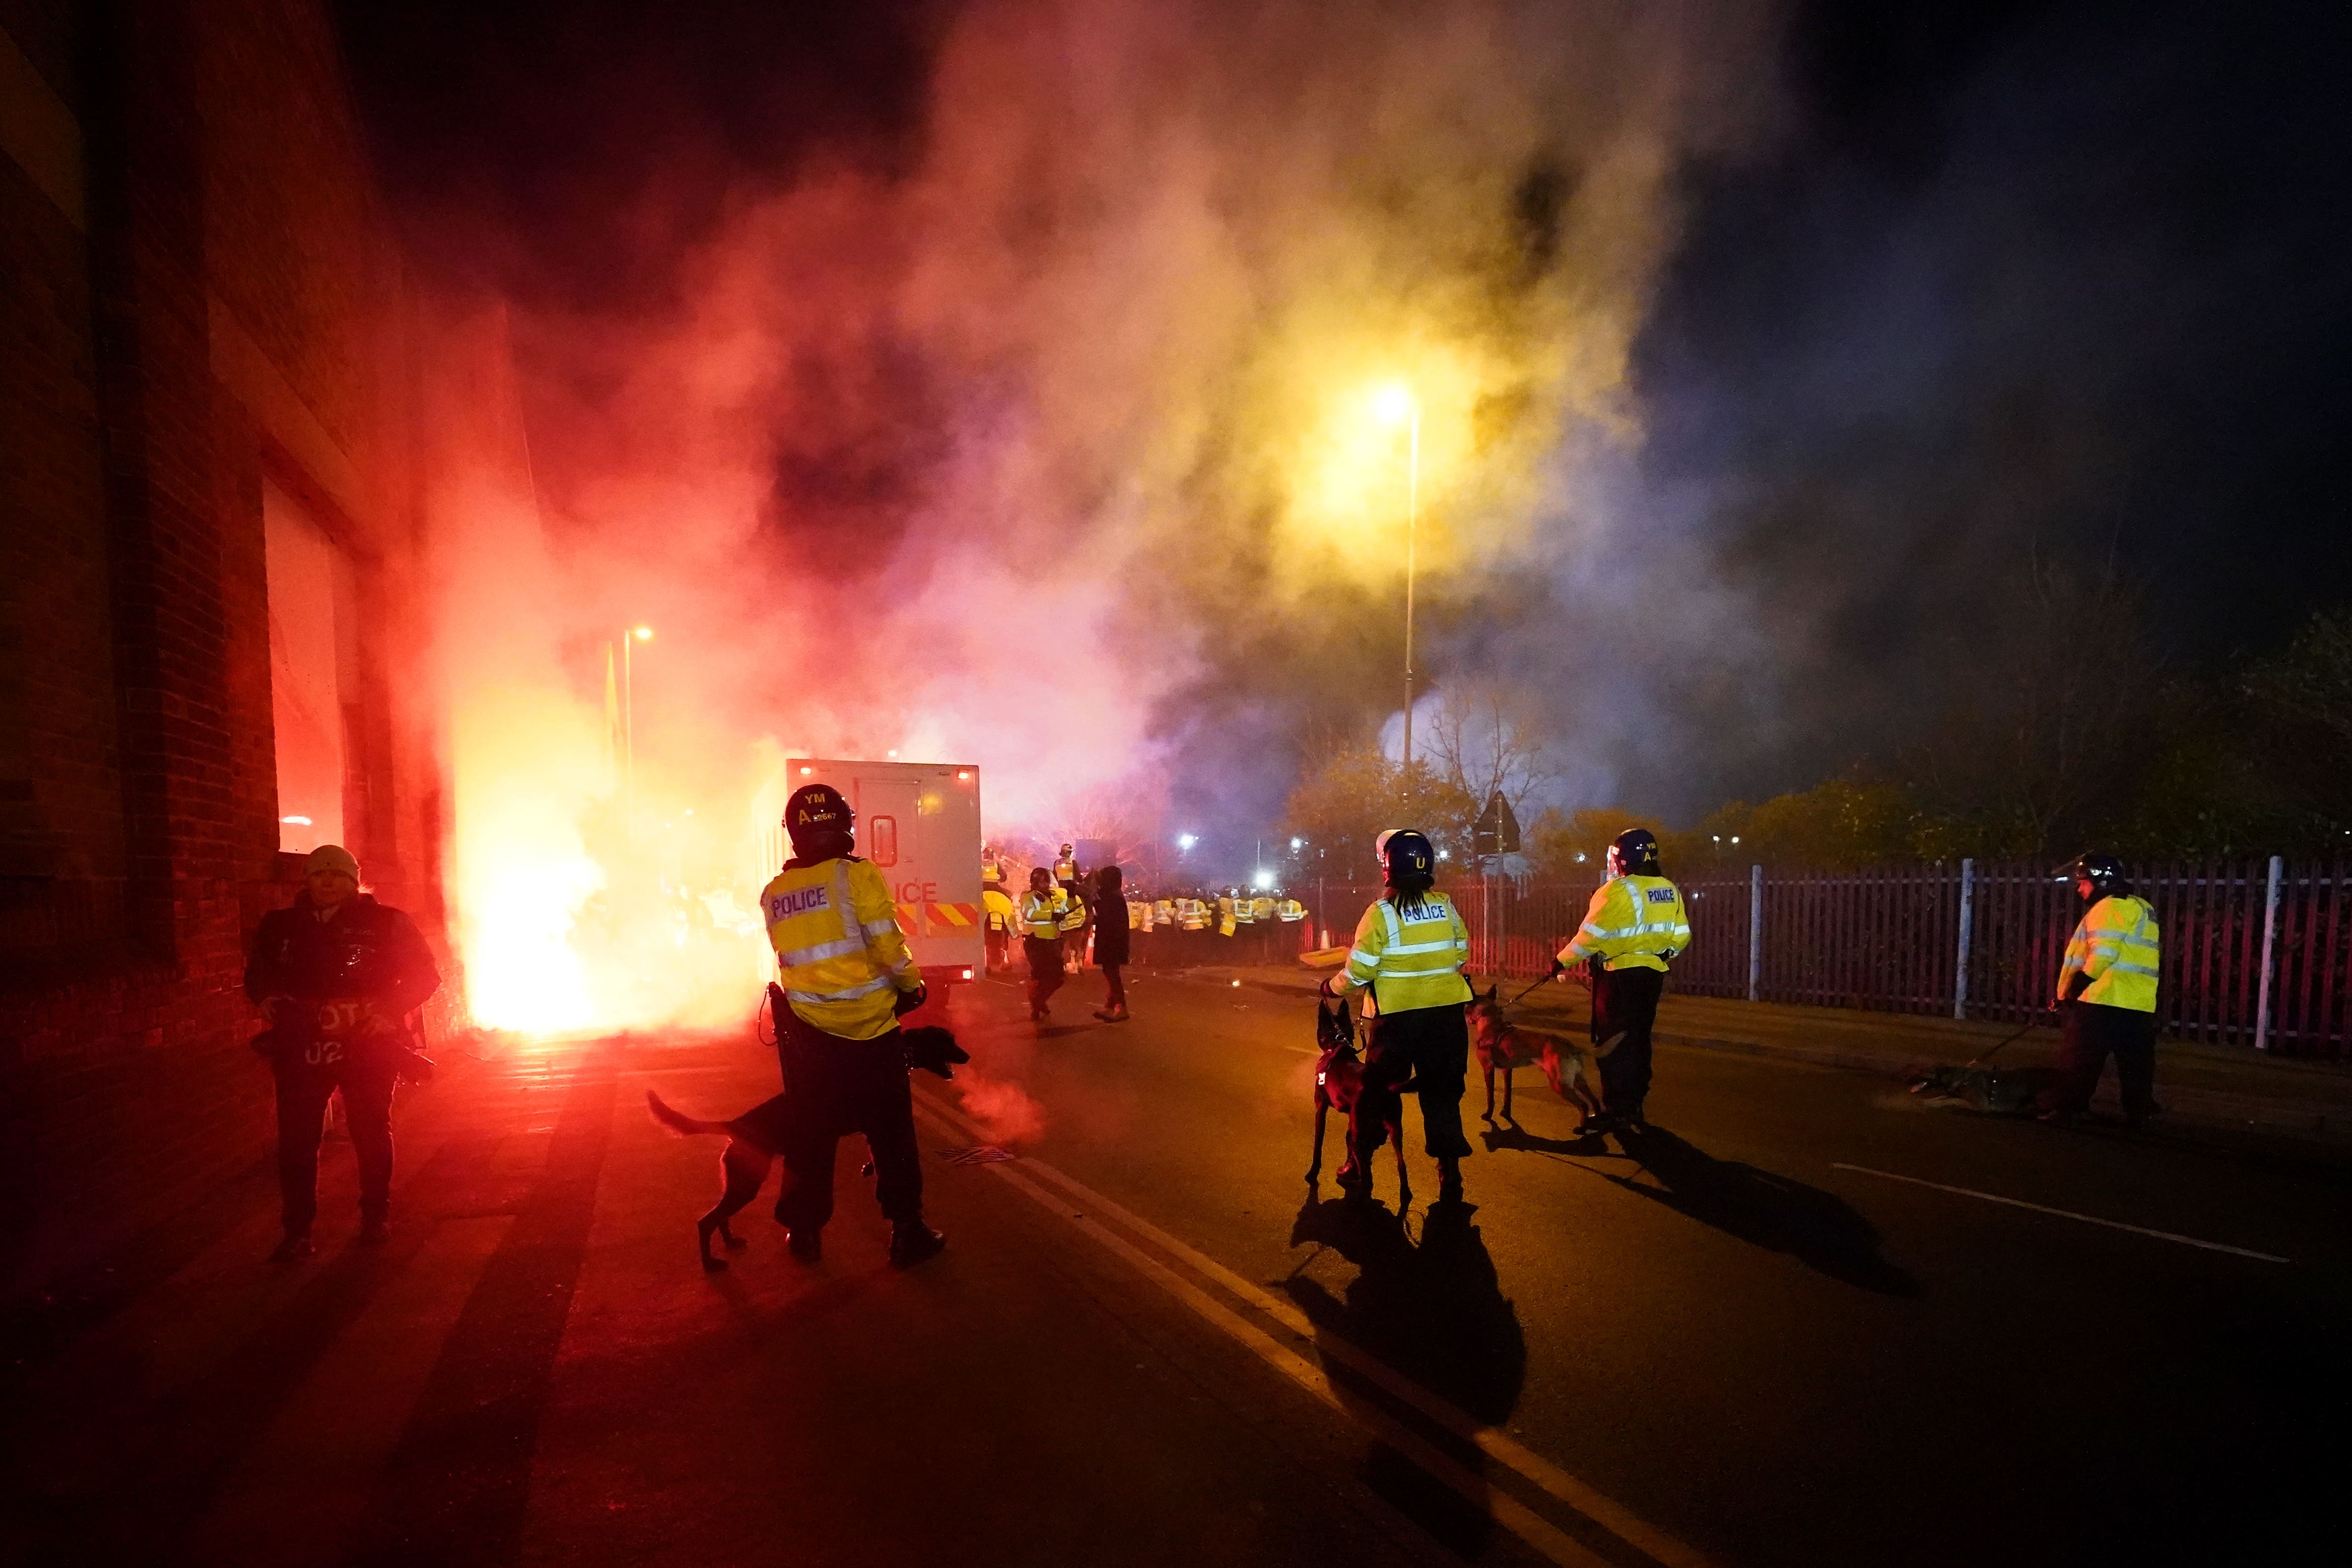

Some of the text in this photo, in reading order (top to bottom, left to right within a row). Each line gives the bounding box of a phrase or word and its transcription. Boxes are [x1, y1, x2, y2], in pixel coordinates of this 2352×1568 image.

[805, 793, 825, 804] YM
[799, 809, 812, 825] A
[1416, 857, 1426, 869] U
[1644, 851, 1651, 861] A
[895, 882, 937, 904] ICE
[1648, 889, 1675, 902] POLICE
[772, 887, 827, 918] POLICE
[1403, 905, 1446, 922] POLICE
